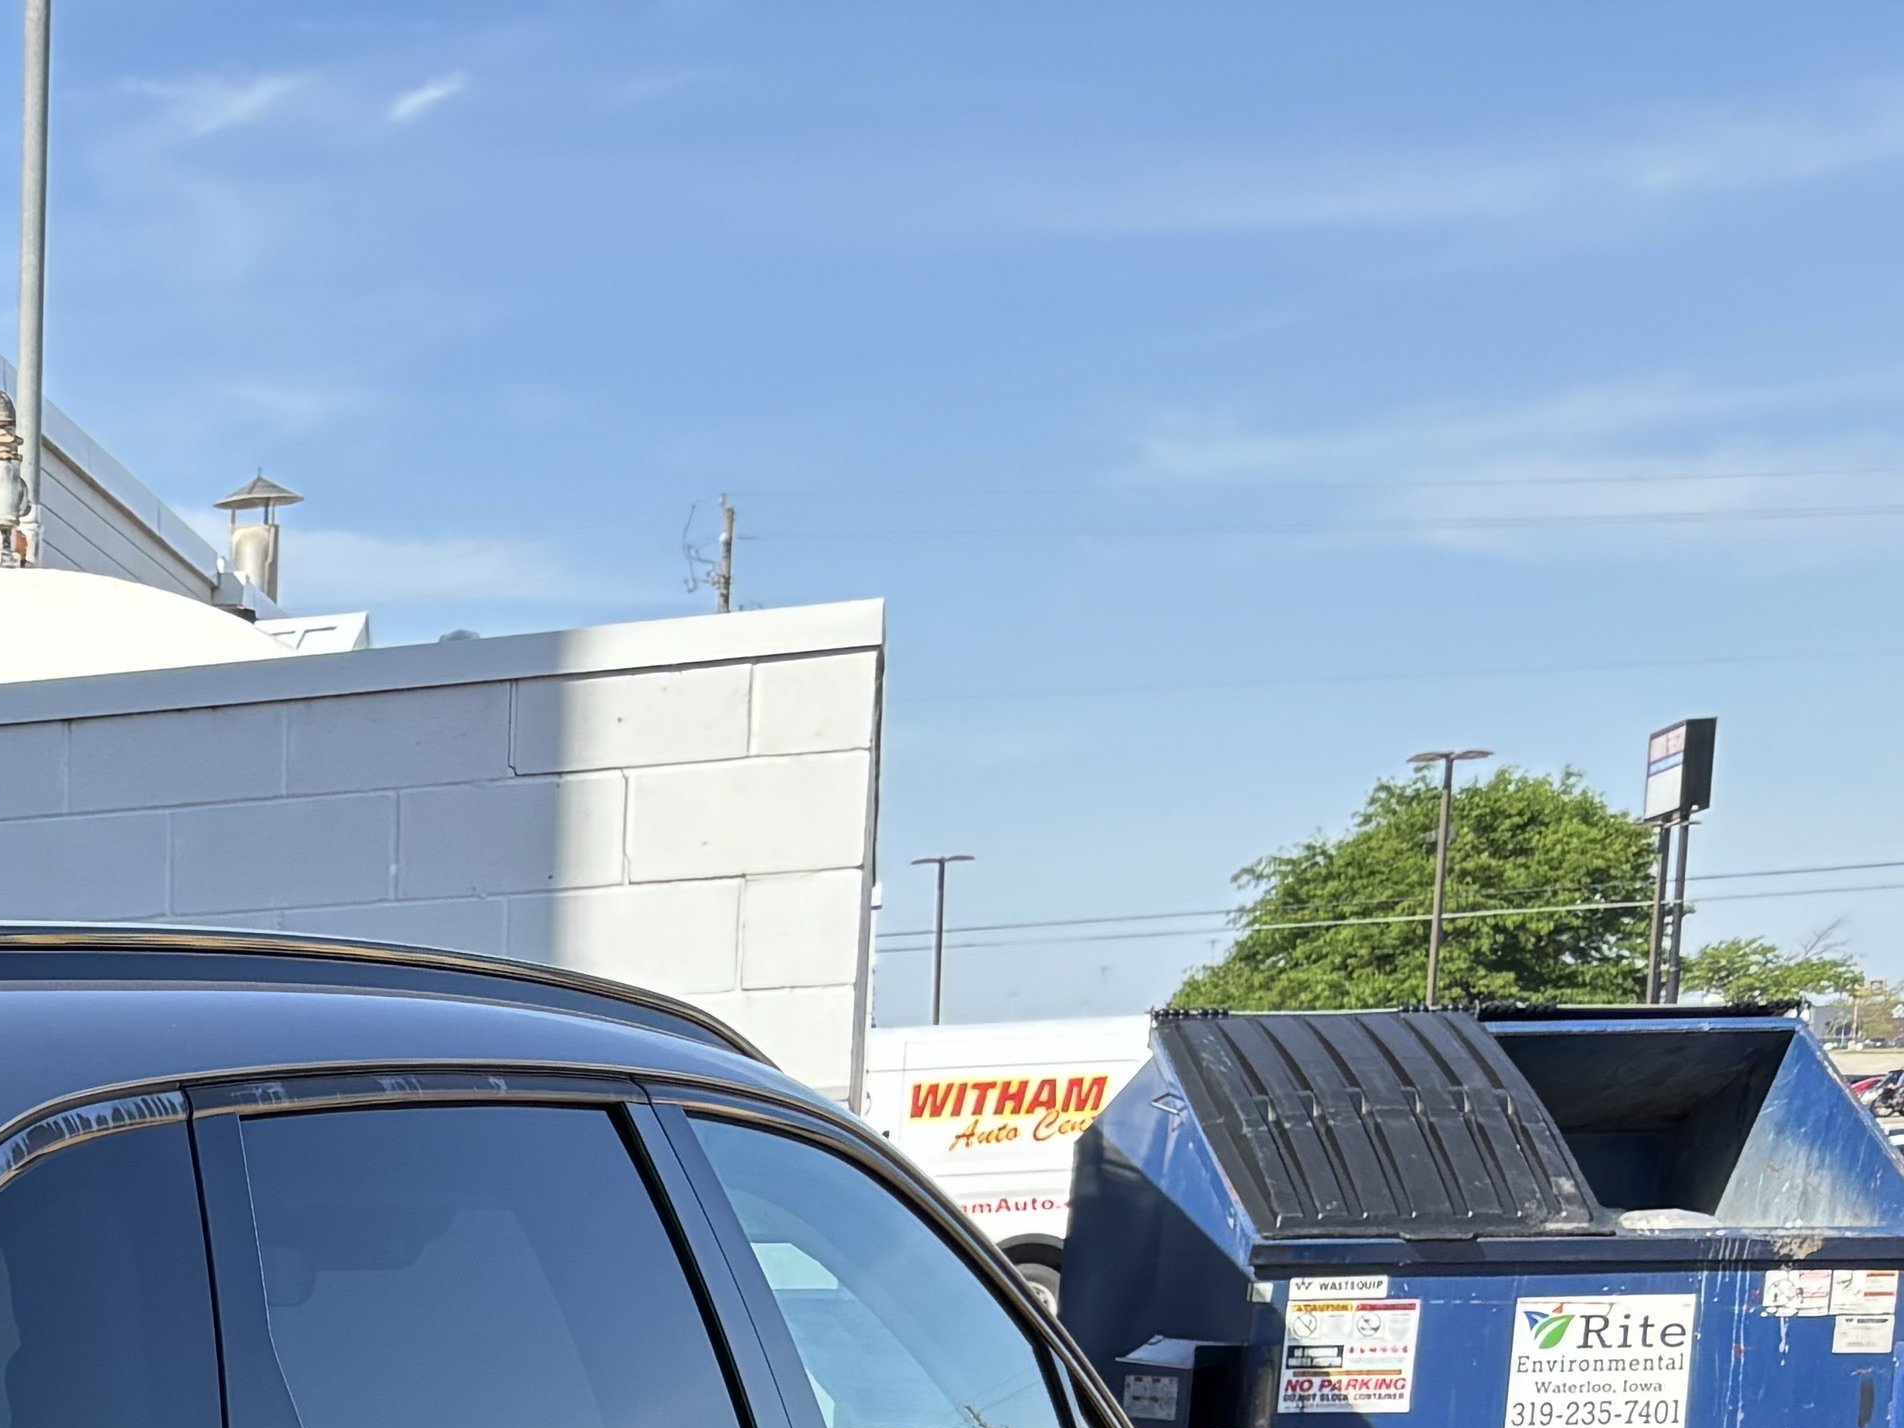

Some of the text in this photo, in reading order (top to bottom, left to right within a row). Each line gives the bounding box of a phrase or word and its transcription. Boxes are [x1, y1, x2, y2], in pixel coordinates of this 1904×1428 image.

[909, 1075, 1109, 1119] WITHAM
[948, 1119, 1022, 1151] Auto
[1576, 1313, 1687, 1349] Rite
[1517, 1353, 1684, 1373] Environmental
[1285, 1377, 1407, 1393] NO PARKING
[1534, 1380, 1663, 1394] Waterloo, Iowa
[1510, 1399, 1680, 1427] 319-235-7401
